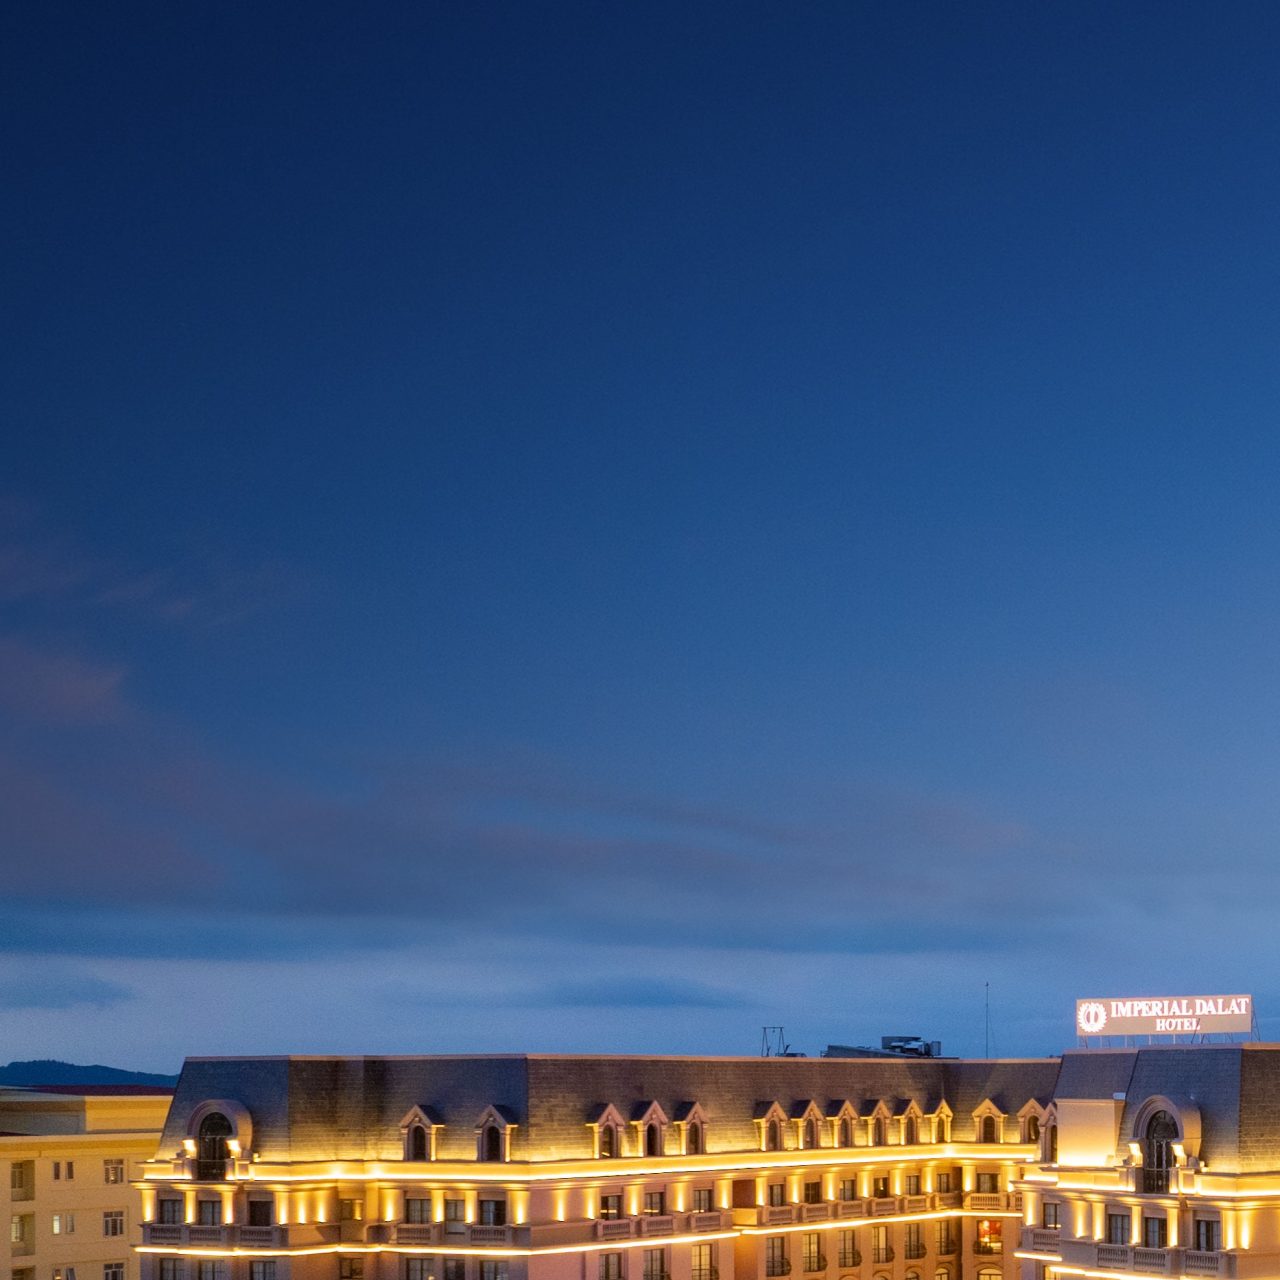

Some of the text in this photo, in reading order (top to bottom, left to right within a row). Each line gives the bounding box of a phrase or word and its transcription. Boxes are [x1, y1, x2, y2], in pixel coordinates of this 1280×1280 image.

[1110, 998, 1249, 1017] IMPERIAL DALAT
[1156, 1018, 1200, 1031] HOTEL
